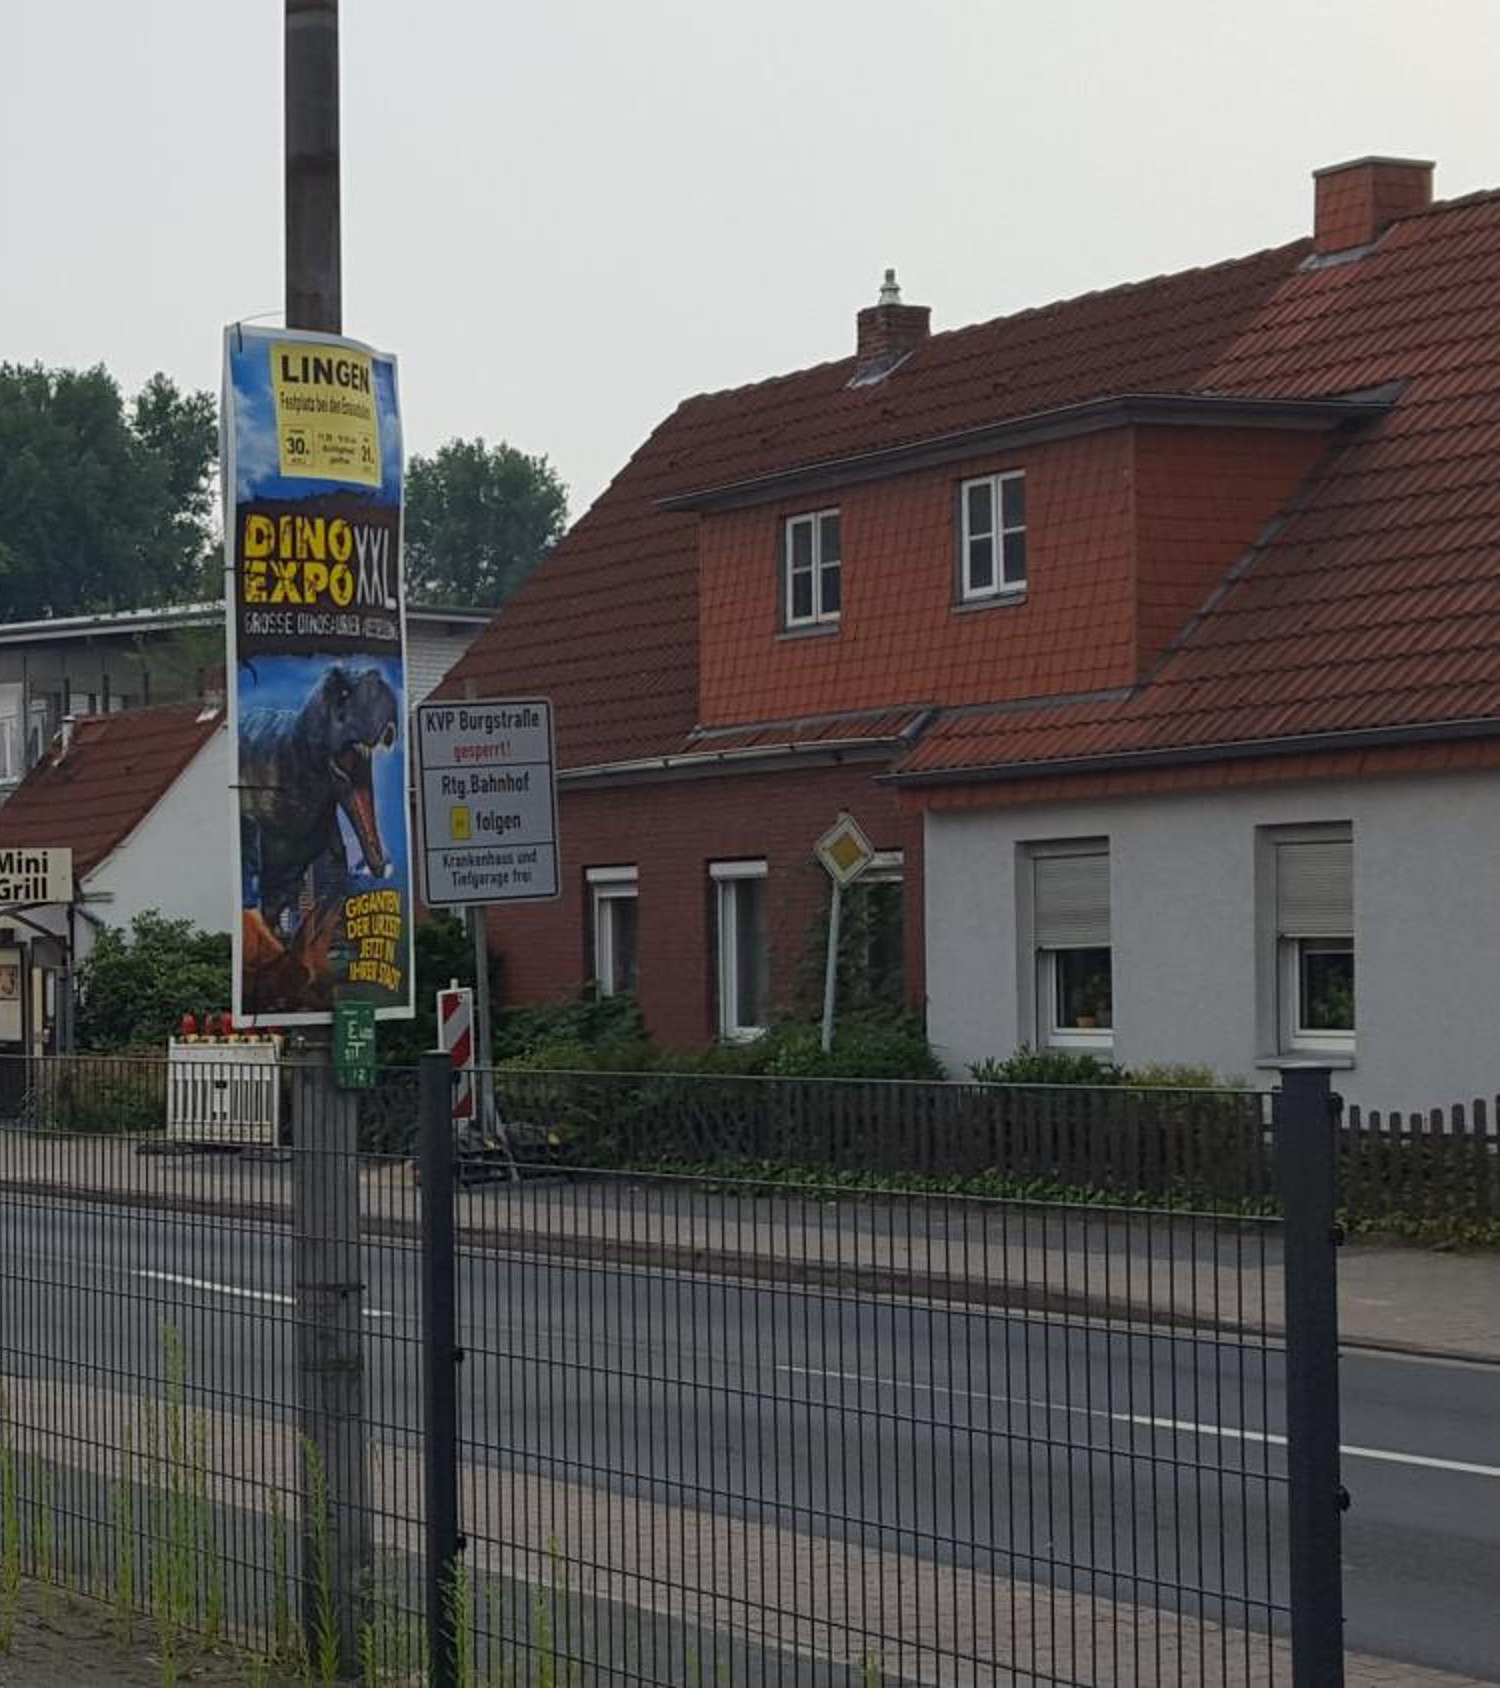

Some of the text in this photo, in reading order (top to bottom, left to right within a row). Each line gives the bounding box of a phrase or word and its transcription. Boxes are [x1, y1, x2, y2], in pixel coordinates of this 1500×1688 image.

[281, 354, 370, 395] LINGEN
[244, 514, 353, 561] DINO
[354, 523, 398, 610] XXL
[244, 560, 354, 607] EXPO
[245, 611, 293, 635] GROSSE
[426, 708, 540, 734] KVP Burgstraße
[476, 809, 521, 834] folgen
[443, 849, 537, 869] Krankenhaus und
[452, 868, 532, 889] Tiefgarage frei
[346, 890, 401, 918] GIGANTEN
[347, 914, 401, 940] DER URZEIT
[359, 938, 385, 960] JETZT
[349, 960, 402, 992] IHRER STADT
